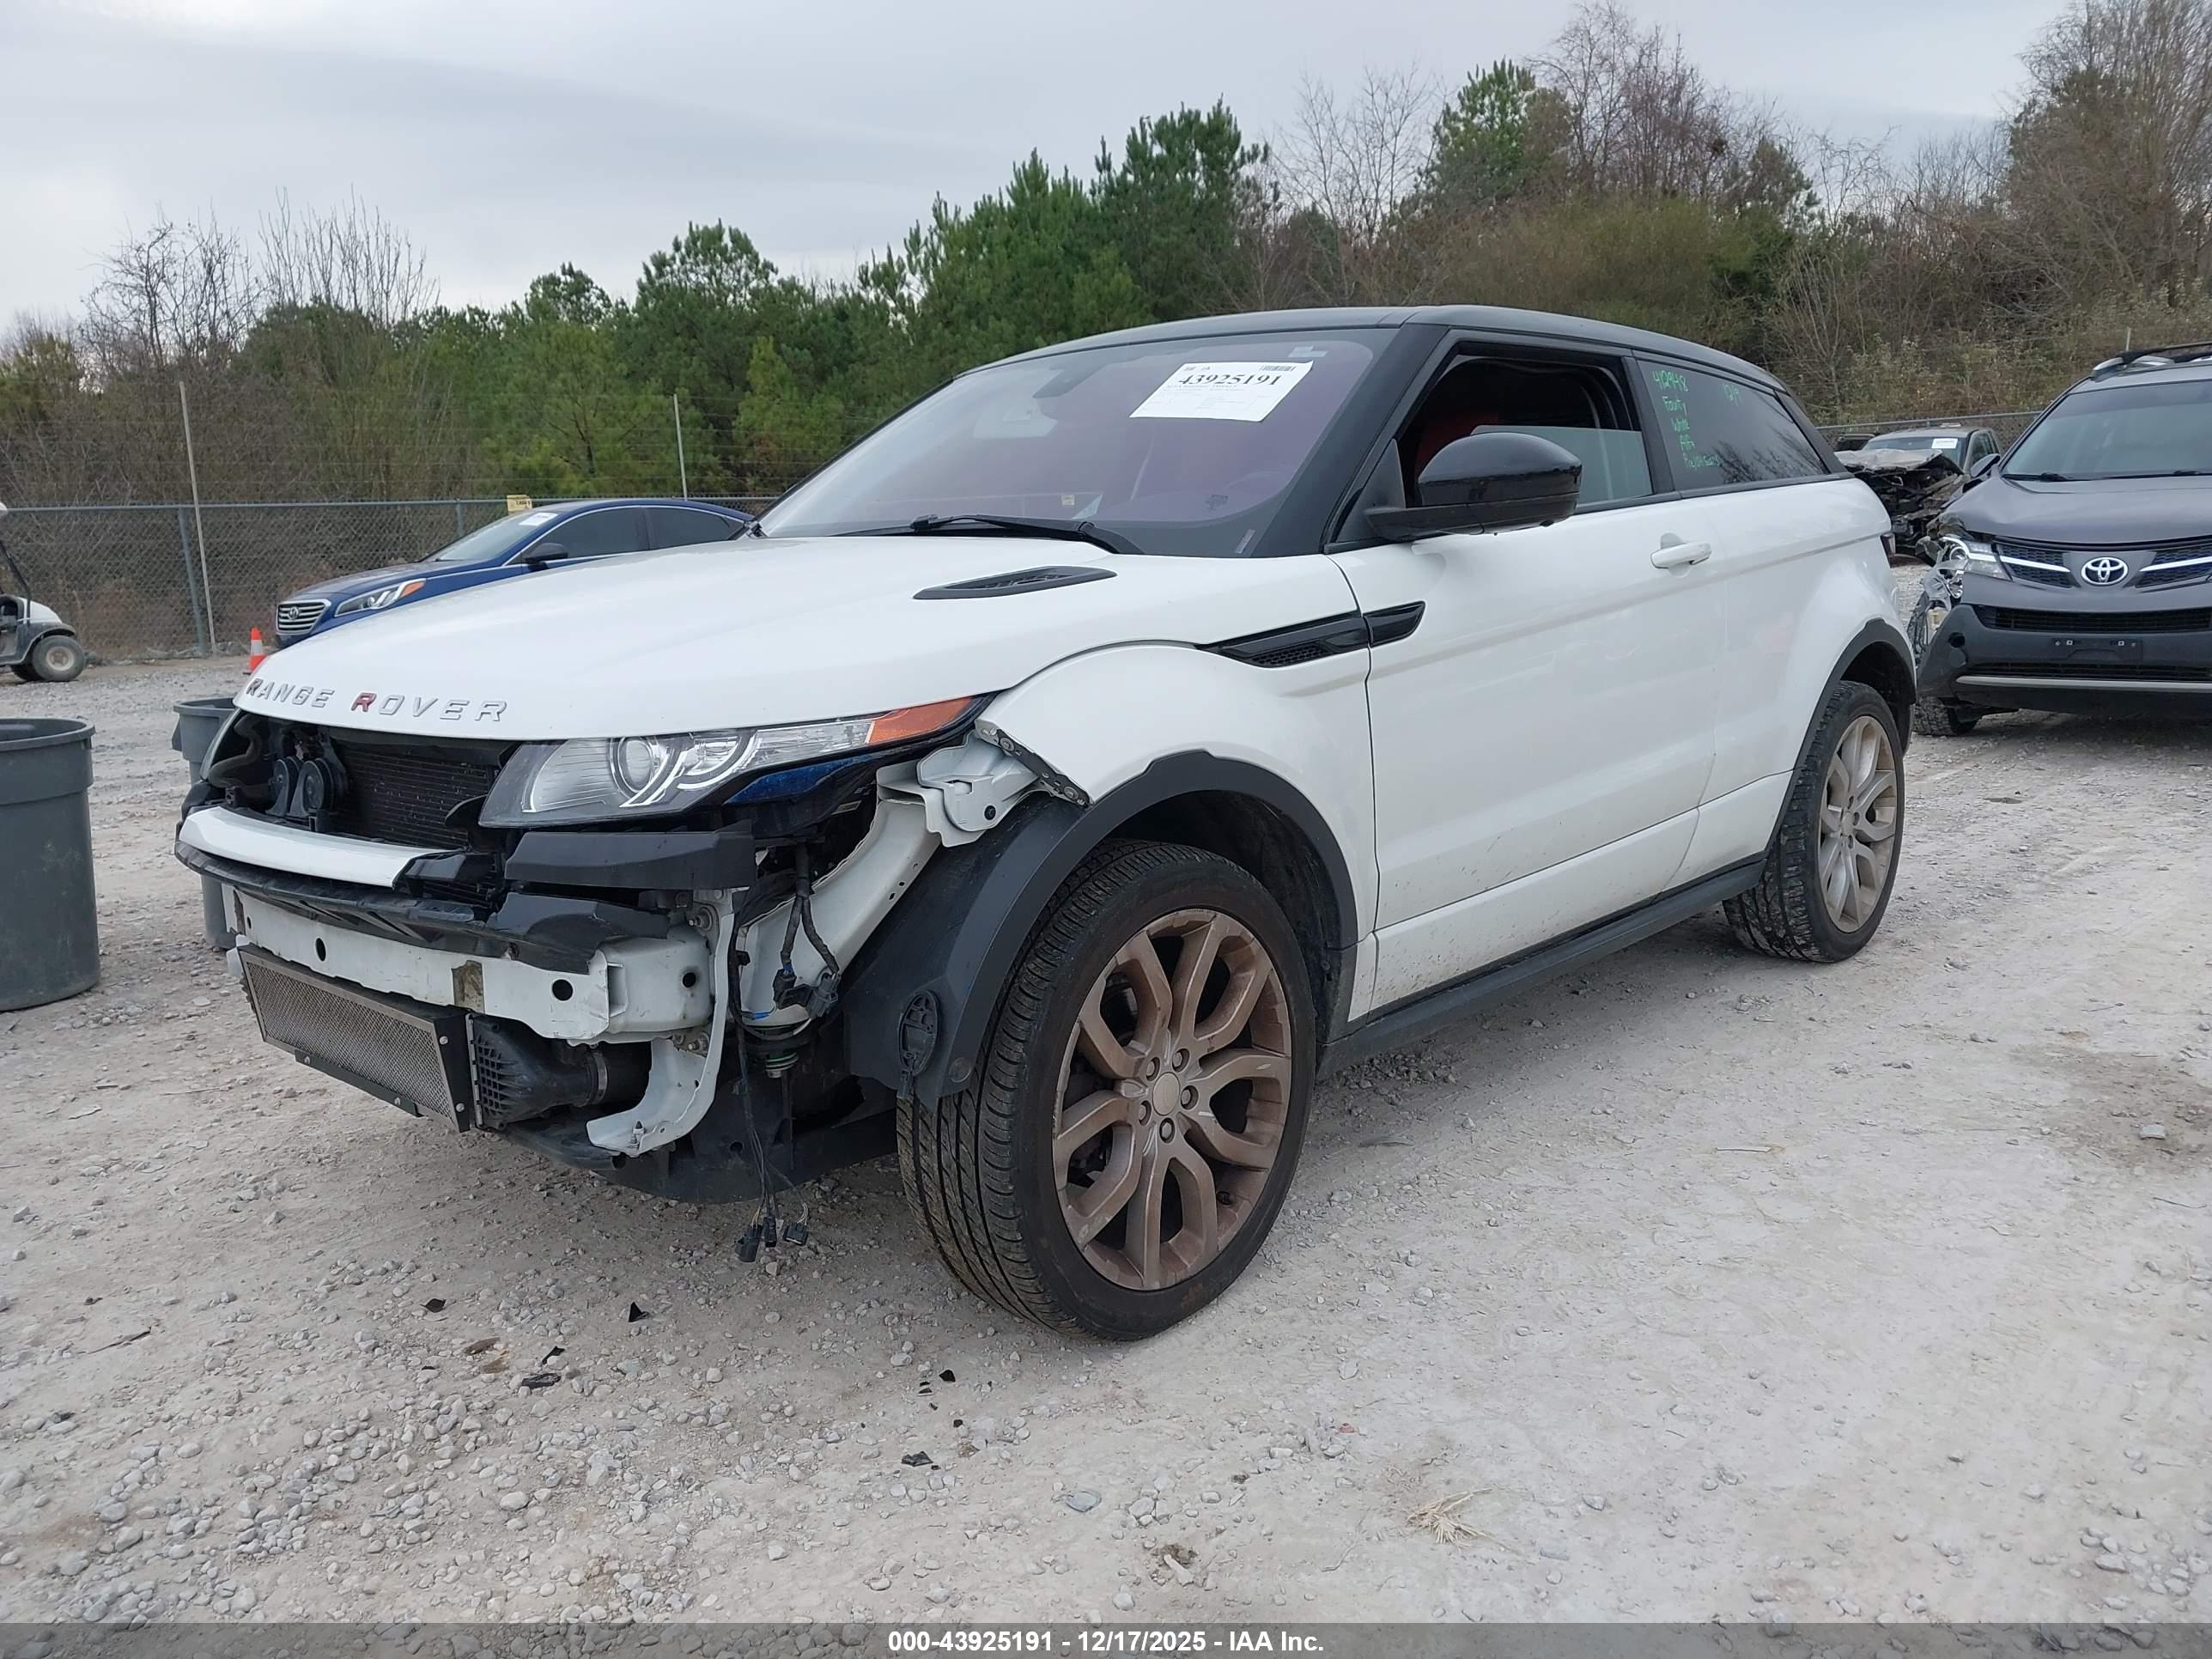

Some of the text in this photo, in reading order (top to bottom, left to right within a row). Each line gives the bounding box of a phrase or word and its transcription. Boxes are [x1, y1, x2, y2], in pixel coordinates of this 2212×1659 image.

[1178, 374, 1283, 386] 43925191
[246, 678, 507, 722] RANGE ROVER
